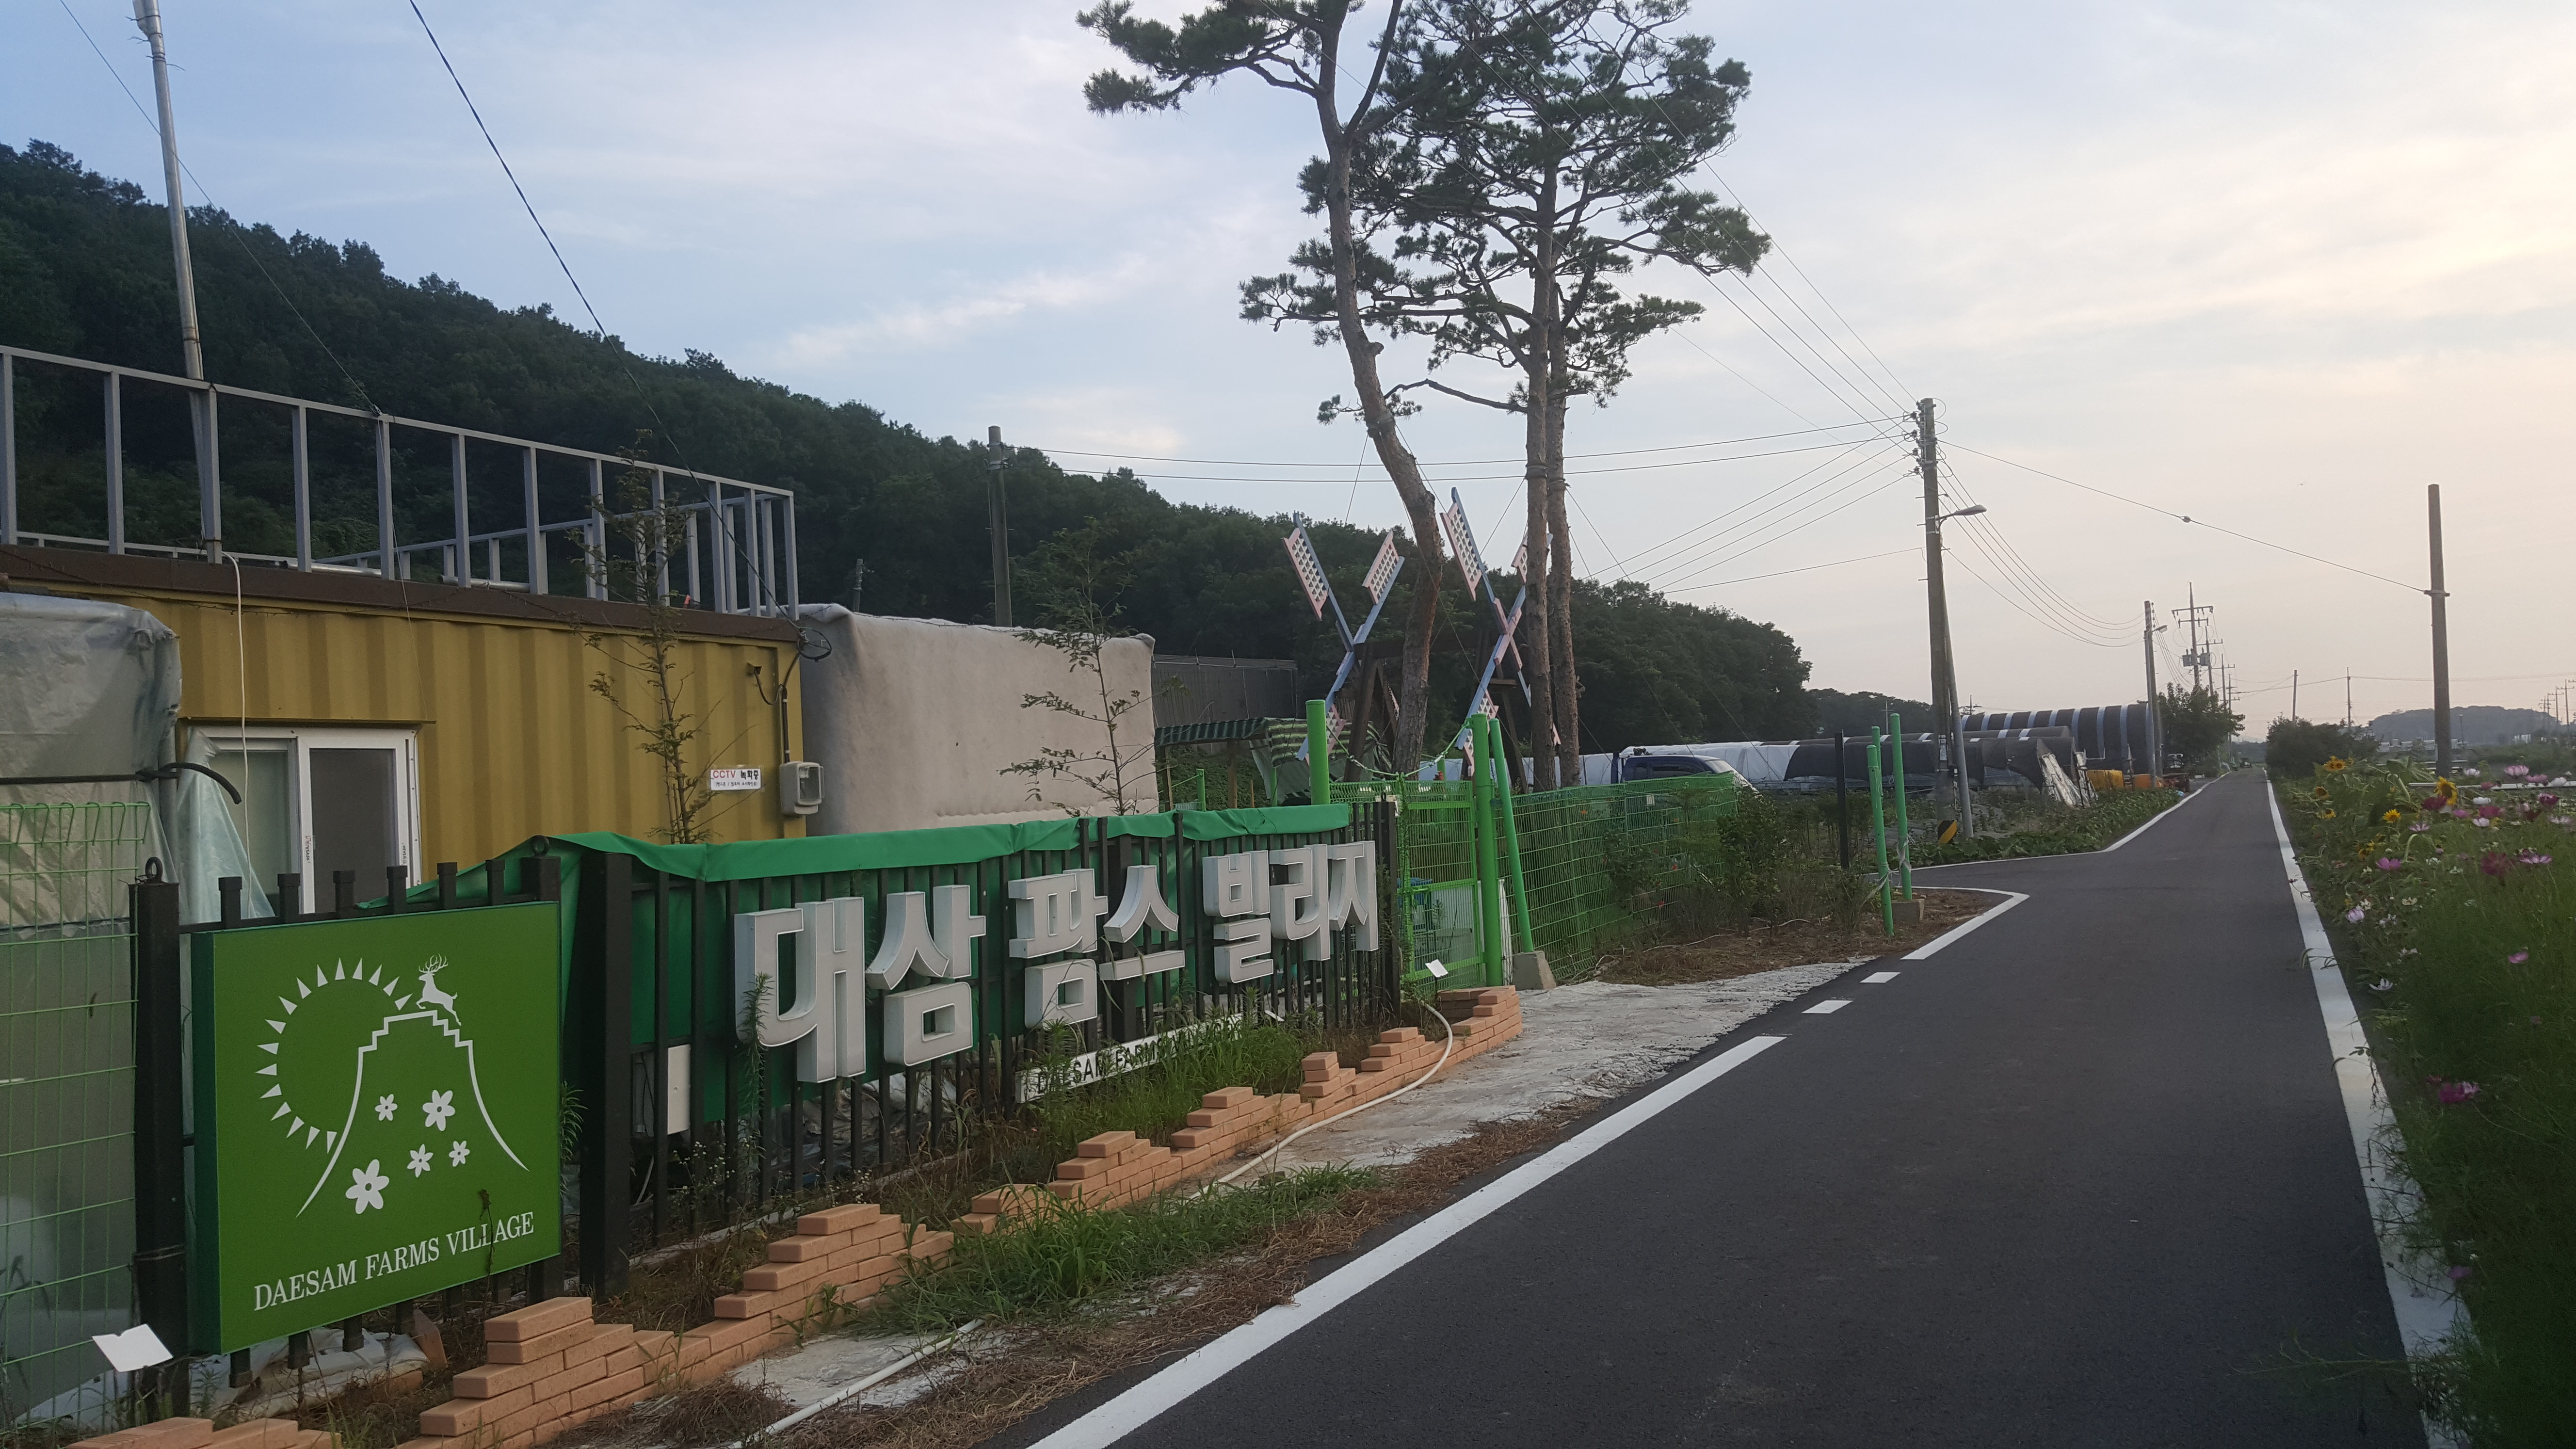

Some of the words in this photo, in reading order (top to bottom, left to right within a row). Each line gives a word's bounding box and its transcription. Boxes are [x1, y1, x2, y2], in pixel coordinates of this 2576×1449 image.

[713, 770, 736, 779] CCTV
[741, 770, 759, 780] 녹화중
[734, 885, 986, 1083] 대삼
[1009, 864, 1186, 1030] 팜스
[1202, 840, 1378, 984] 빌리지
[254, 1259, 357, 1311] DAESAM
[365, 1237, 440, 1280] FARMS
[446, 1211, 534, 1256] VILLAGE
